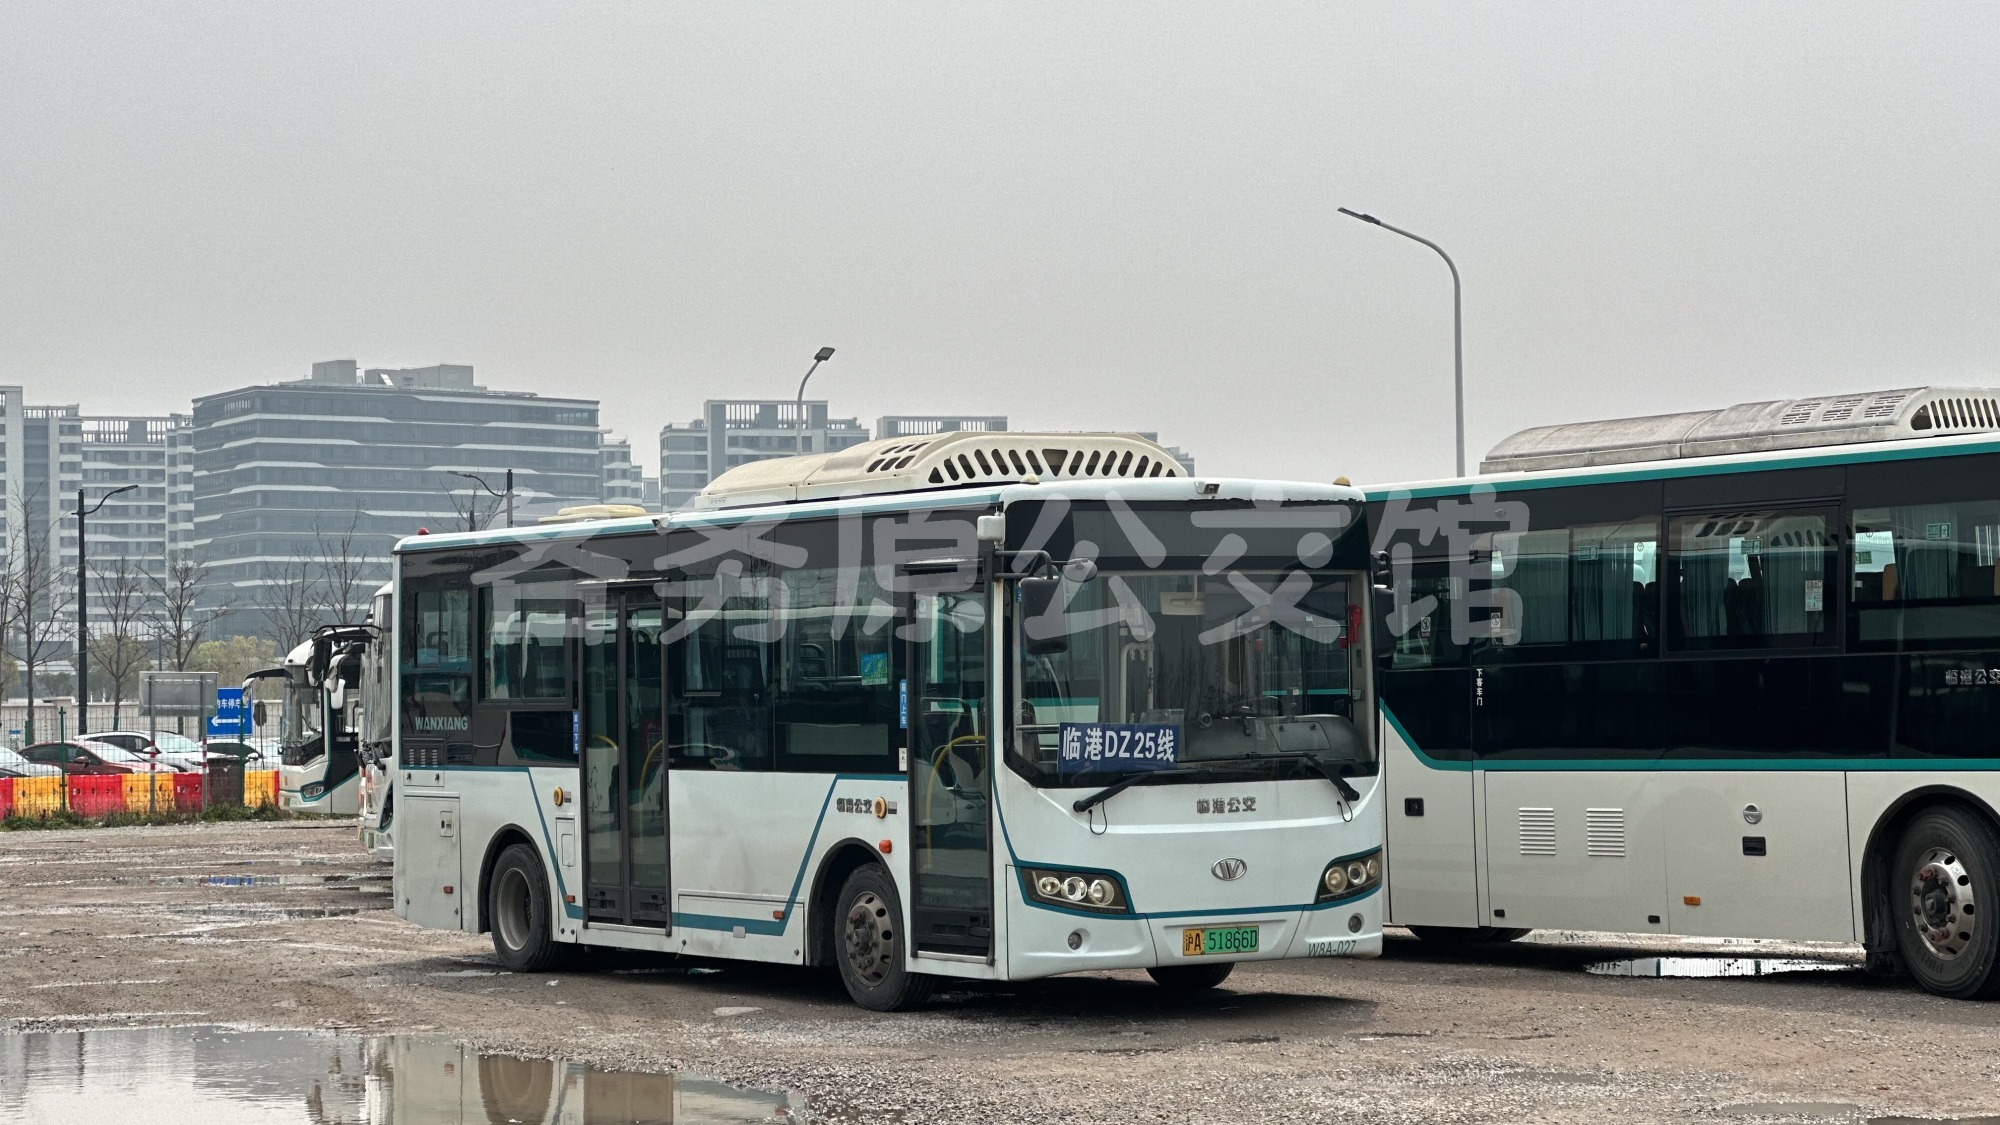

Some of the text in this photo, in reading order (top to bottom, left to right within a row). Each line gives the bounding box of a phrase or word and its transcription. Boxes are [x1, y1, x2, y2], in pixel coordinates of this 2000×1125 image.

[1945, 668, 2000, 686] 临港公交
[1475, 668, 1483, 706] 下客车门
[415, 716, 468, 731] WANXIANG
[1062, 726, 1175, 763] 临港DZ25线
[1196, 796, 1257, 814] 临港公交
[1308, 940, 1357, 958] W8A-027
